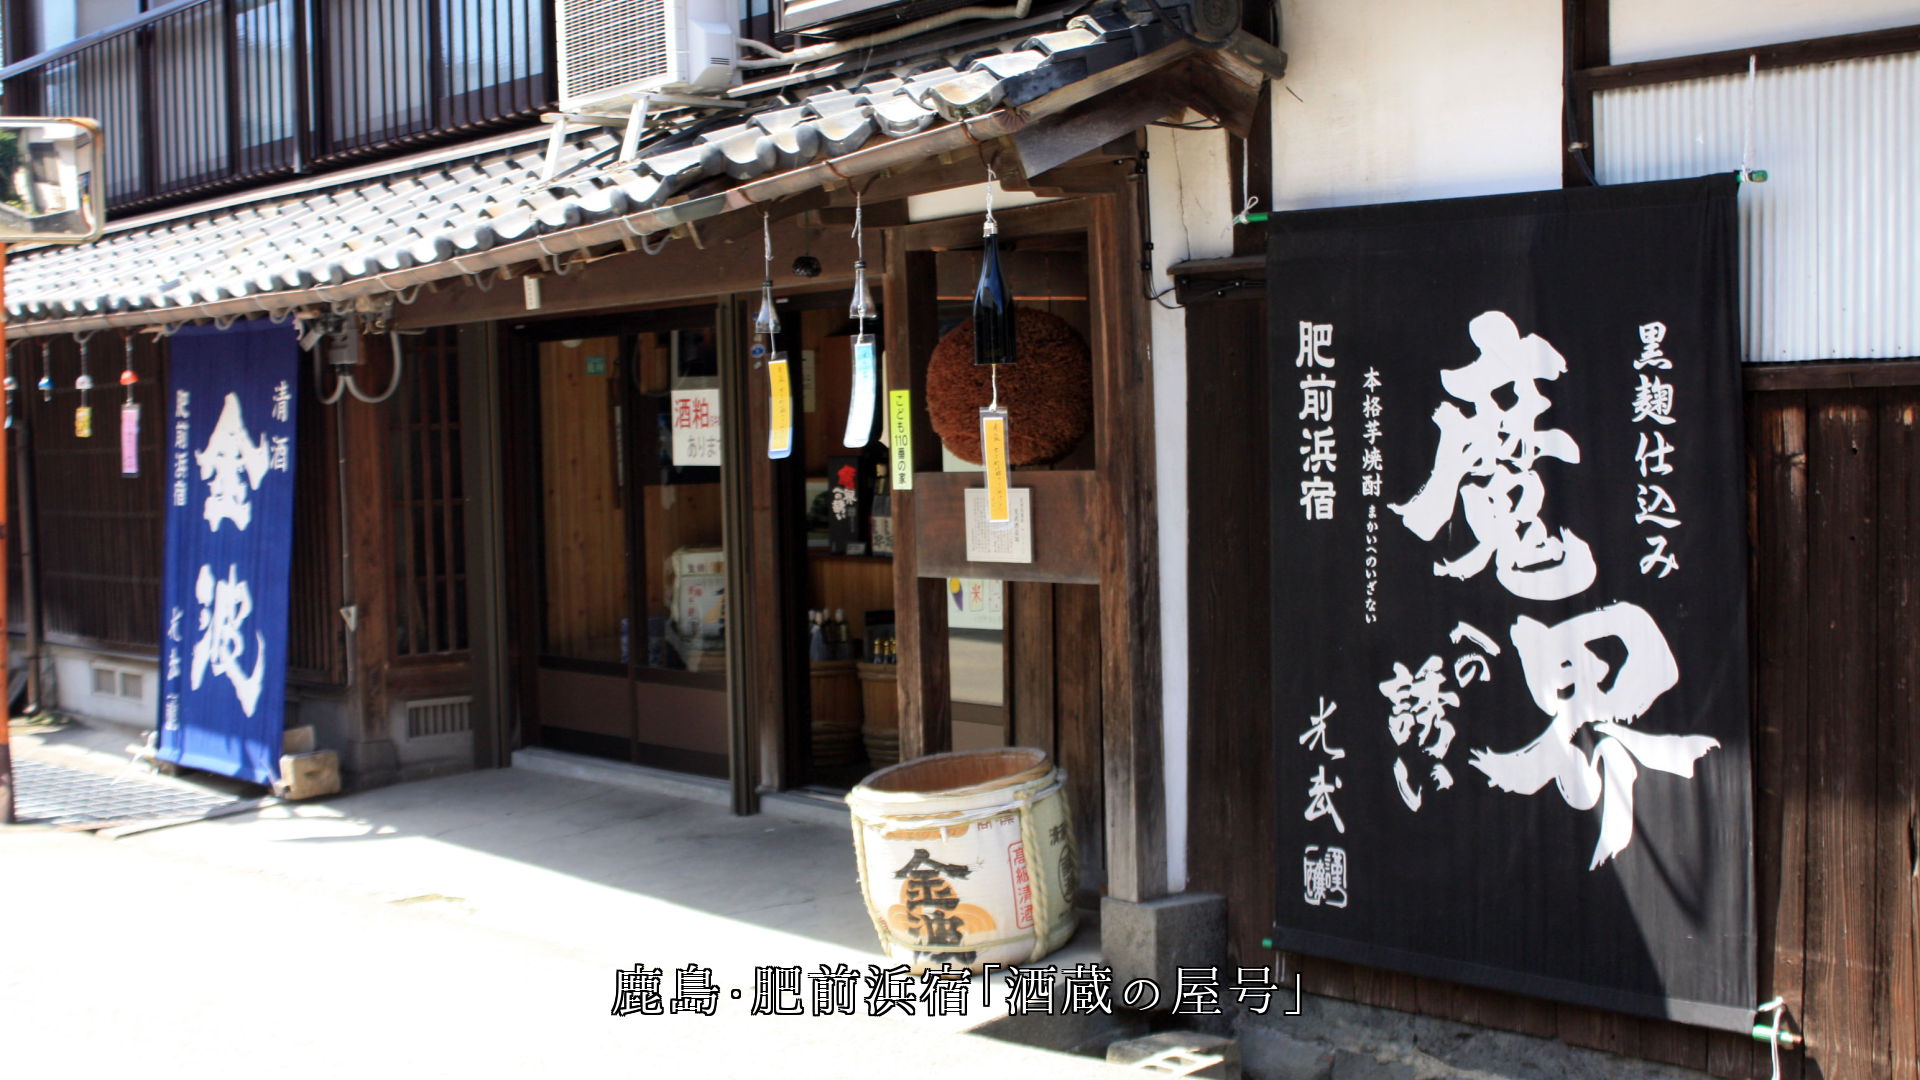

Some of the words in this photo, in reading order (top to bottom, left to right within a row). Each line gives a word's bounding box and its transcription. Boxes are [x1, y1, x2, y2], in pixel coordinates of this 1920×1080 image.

[270, 379, 292, 473] 清酒
[675, 397, 710, 429] 酒粕
[1296, 320, 1336, 521] 肥前浜宿
[1362, 366, 1383, 497] 本格芋焼酎
[1632, 321, 1681, 579] 黒麹仕込み
[191, 391, 270, 718] 金波
[1366, 504, 1379, 624] まかいへのいざない
[1387, 310, 1720, 871] 魔界
